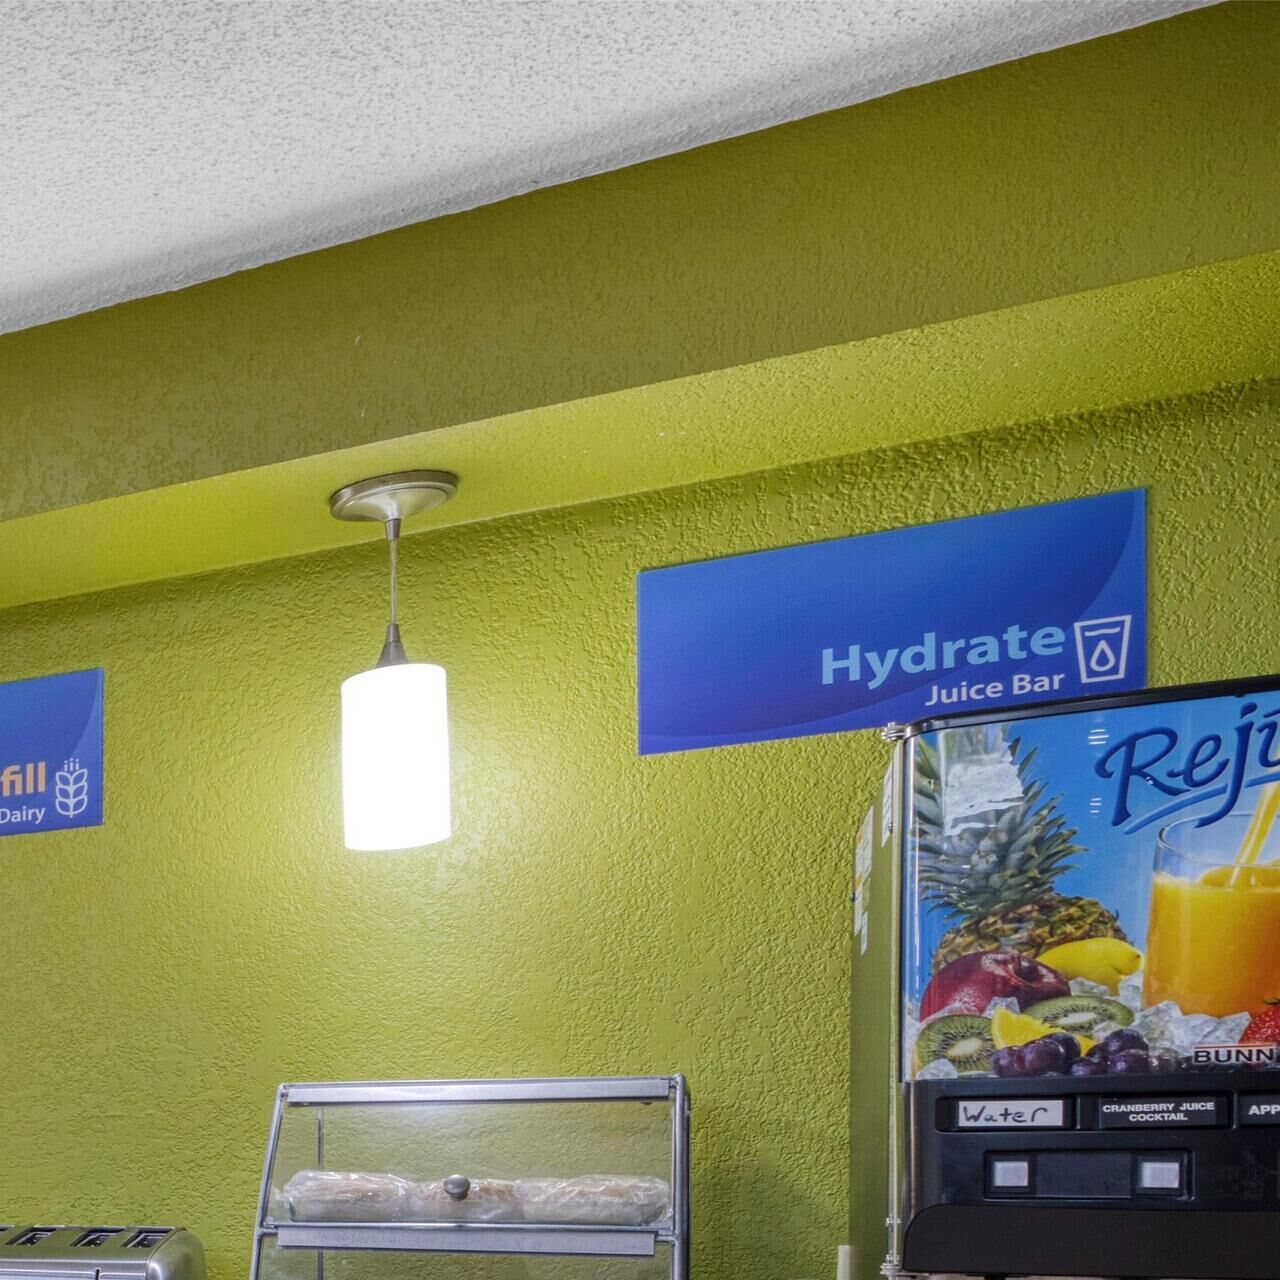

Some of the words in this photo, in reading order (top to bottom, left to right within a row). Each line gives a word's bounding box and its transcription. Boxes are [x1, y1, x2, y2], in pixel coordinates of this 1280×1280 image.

[821, 622, 1065, 690] Hydrate
[924, 677, 1003, 707] Juice
[1013, 669, 1065, 697] Bar
[1193, 1047, 1274, 1063] BUNN
[963, 1105, 1048, 1123] Water
[1102, 1103, 1175, 1113] CRANBERRY
[1179, 1102, 1215, 1110] JUICE
[1129, 1113, 1188, 1122] COCKTAIL
